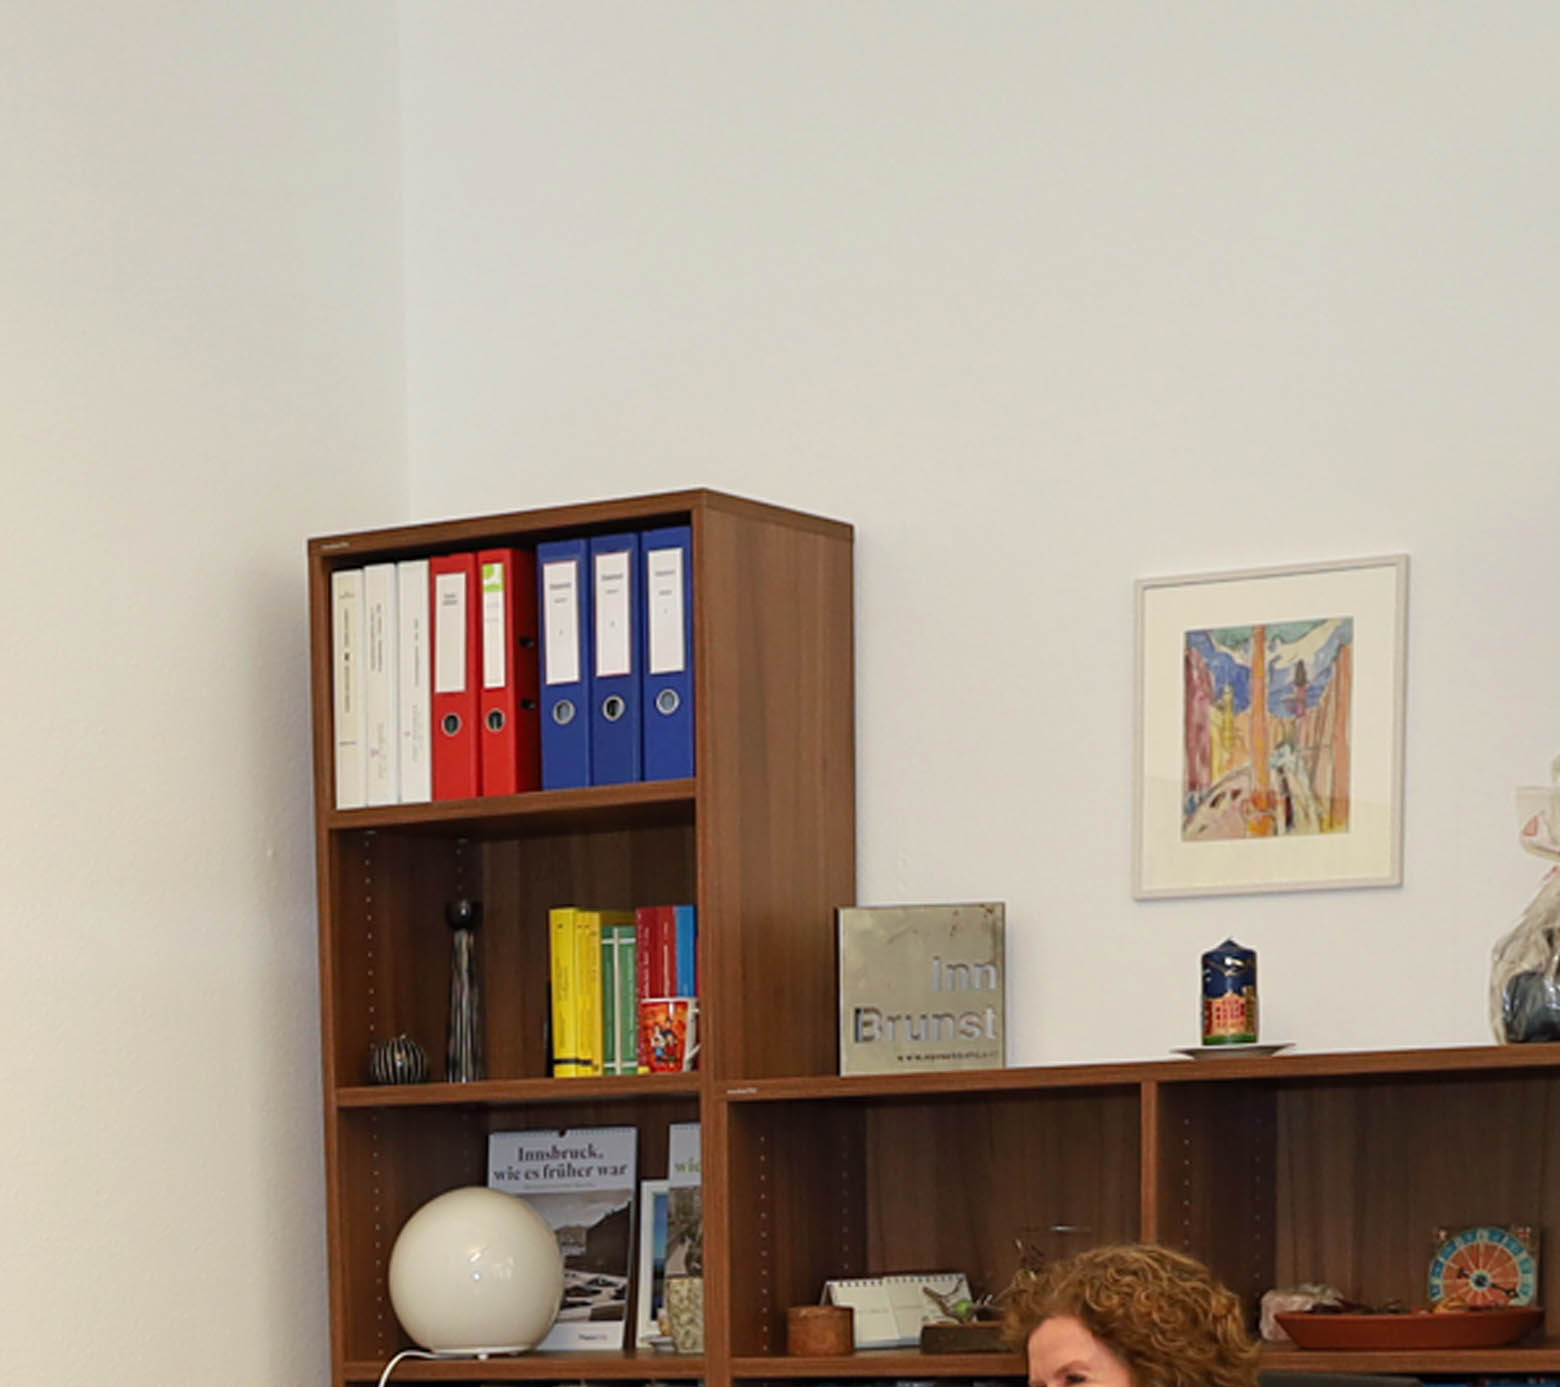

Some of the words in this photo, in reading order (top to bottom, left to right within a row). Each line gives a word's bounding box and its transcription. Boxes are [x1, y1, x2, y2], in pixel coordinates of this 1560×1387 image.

[930, 955, 998, 993] inn
[854, 1005, 998, 1044] Brunst
[494, 1165, 520, 1181] wie
[524, 1168, 539, 1180] es
[543, 1162, 593, 1180] früher
[597, 1163, 628, 1177] war
